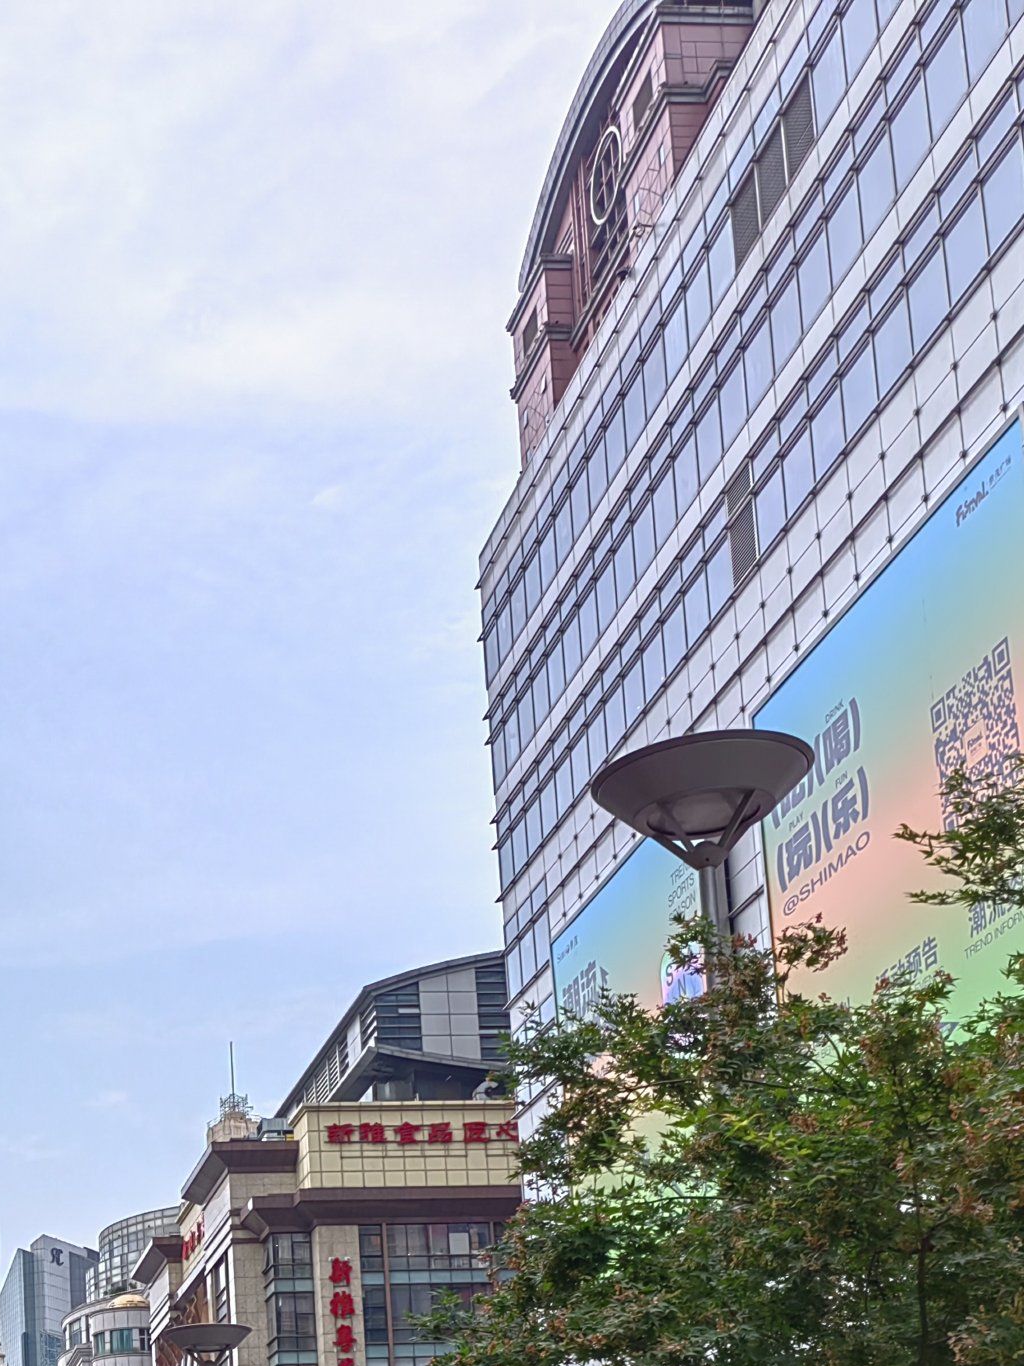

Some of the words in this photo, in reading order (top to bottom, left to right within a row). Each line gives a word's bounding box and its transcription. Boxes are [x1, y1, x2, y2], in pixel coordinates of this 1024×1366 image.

[788, 813, 804, 831] PLAY
[835, 770, 848, 788] FUN
[667, 872, 695, 908] SPORTS
[783, 831, 871, 916] @SHIMAO
[964, 932, 992, 960] TREND
